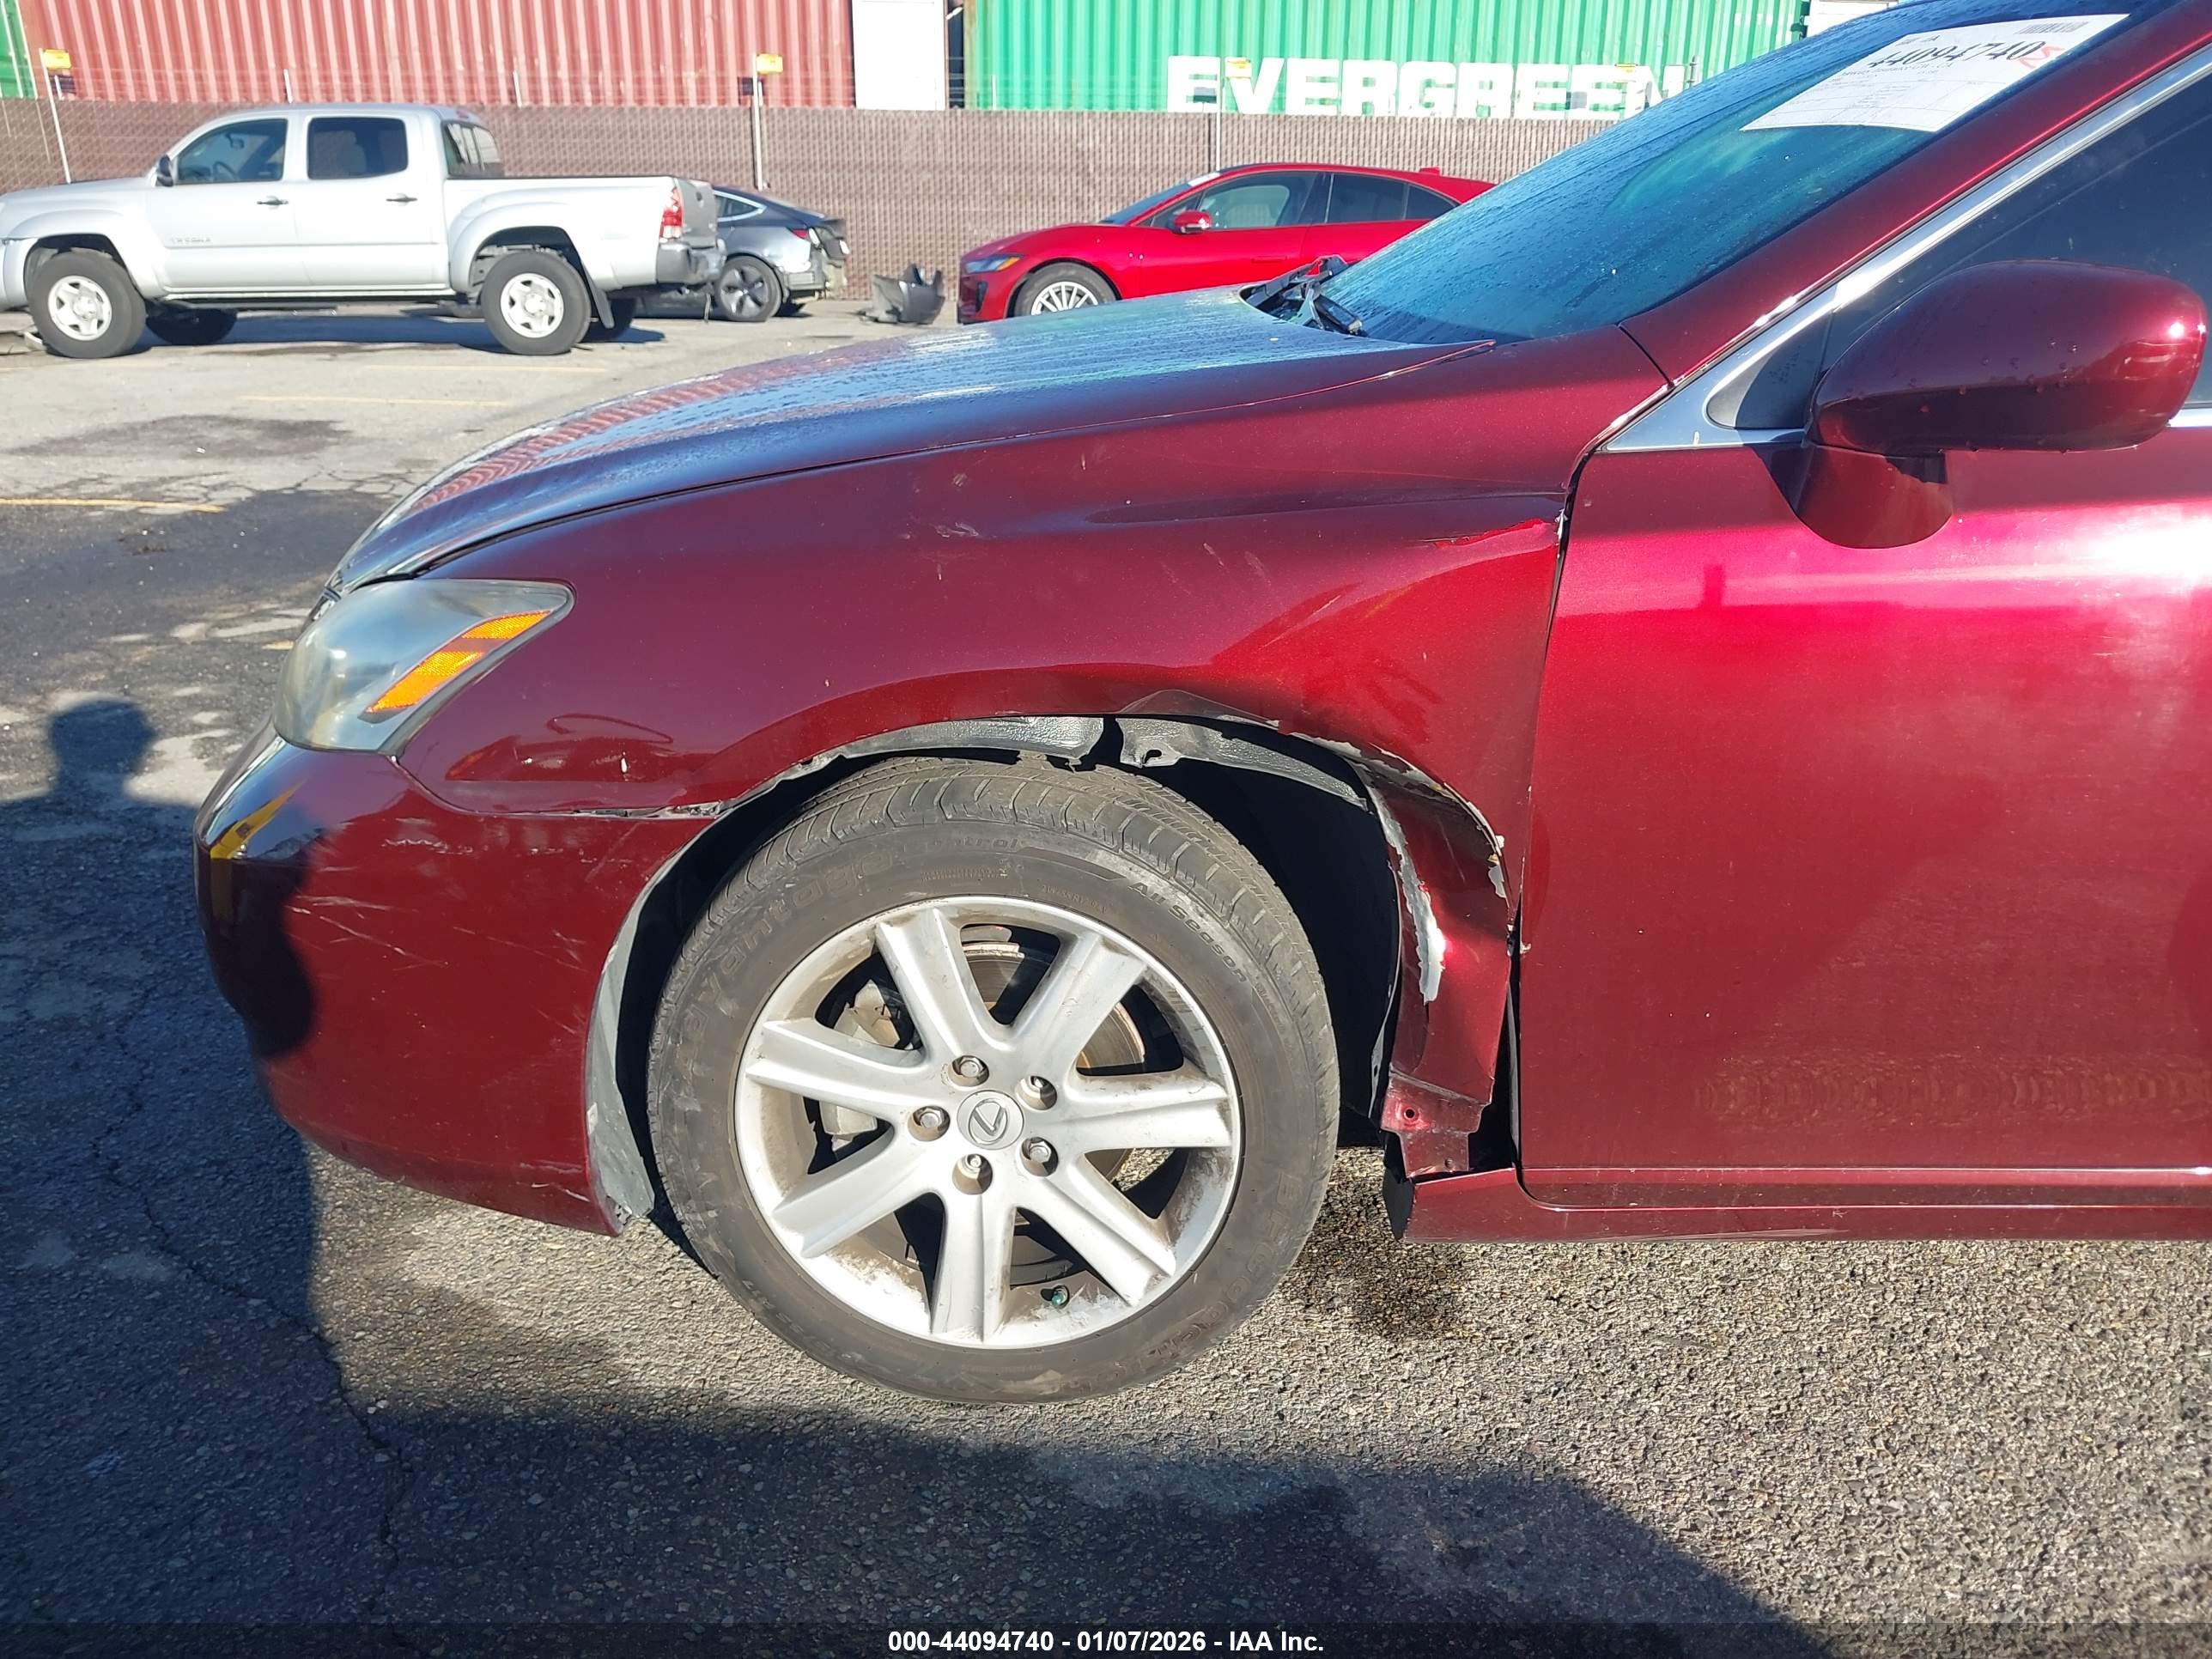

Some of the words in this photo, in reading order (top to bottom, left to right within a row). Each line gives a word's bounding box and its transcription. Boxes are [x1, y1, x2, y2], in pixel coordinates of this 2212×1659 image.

[1868, 40, 2047, 69] 44094740
[1168, 56, 1685, 120] EVERGREEN
[1127, 881, 1167, 906] All
[1168, 903, 1248, 983] Season
